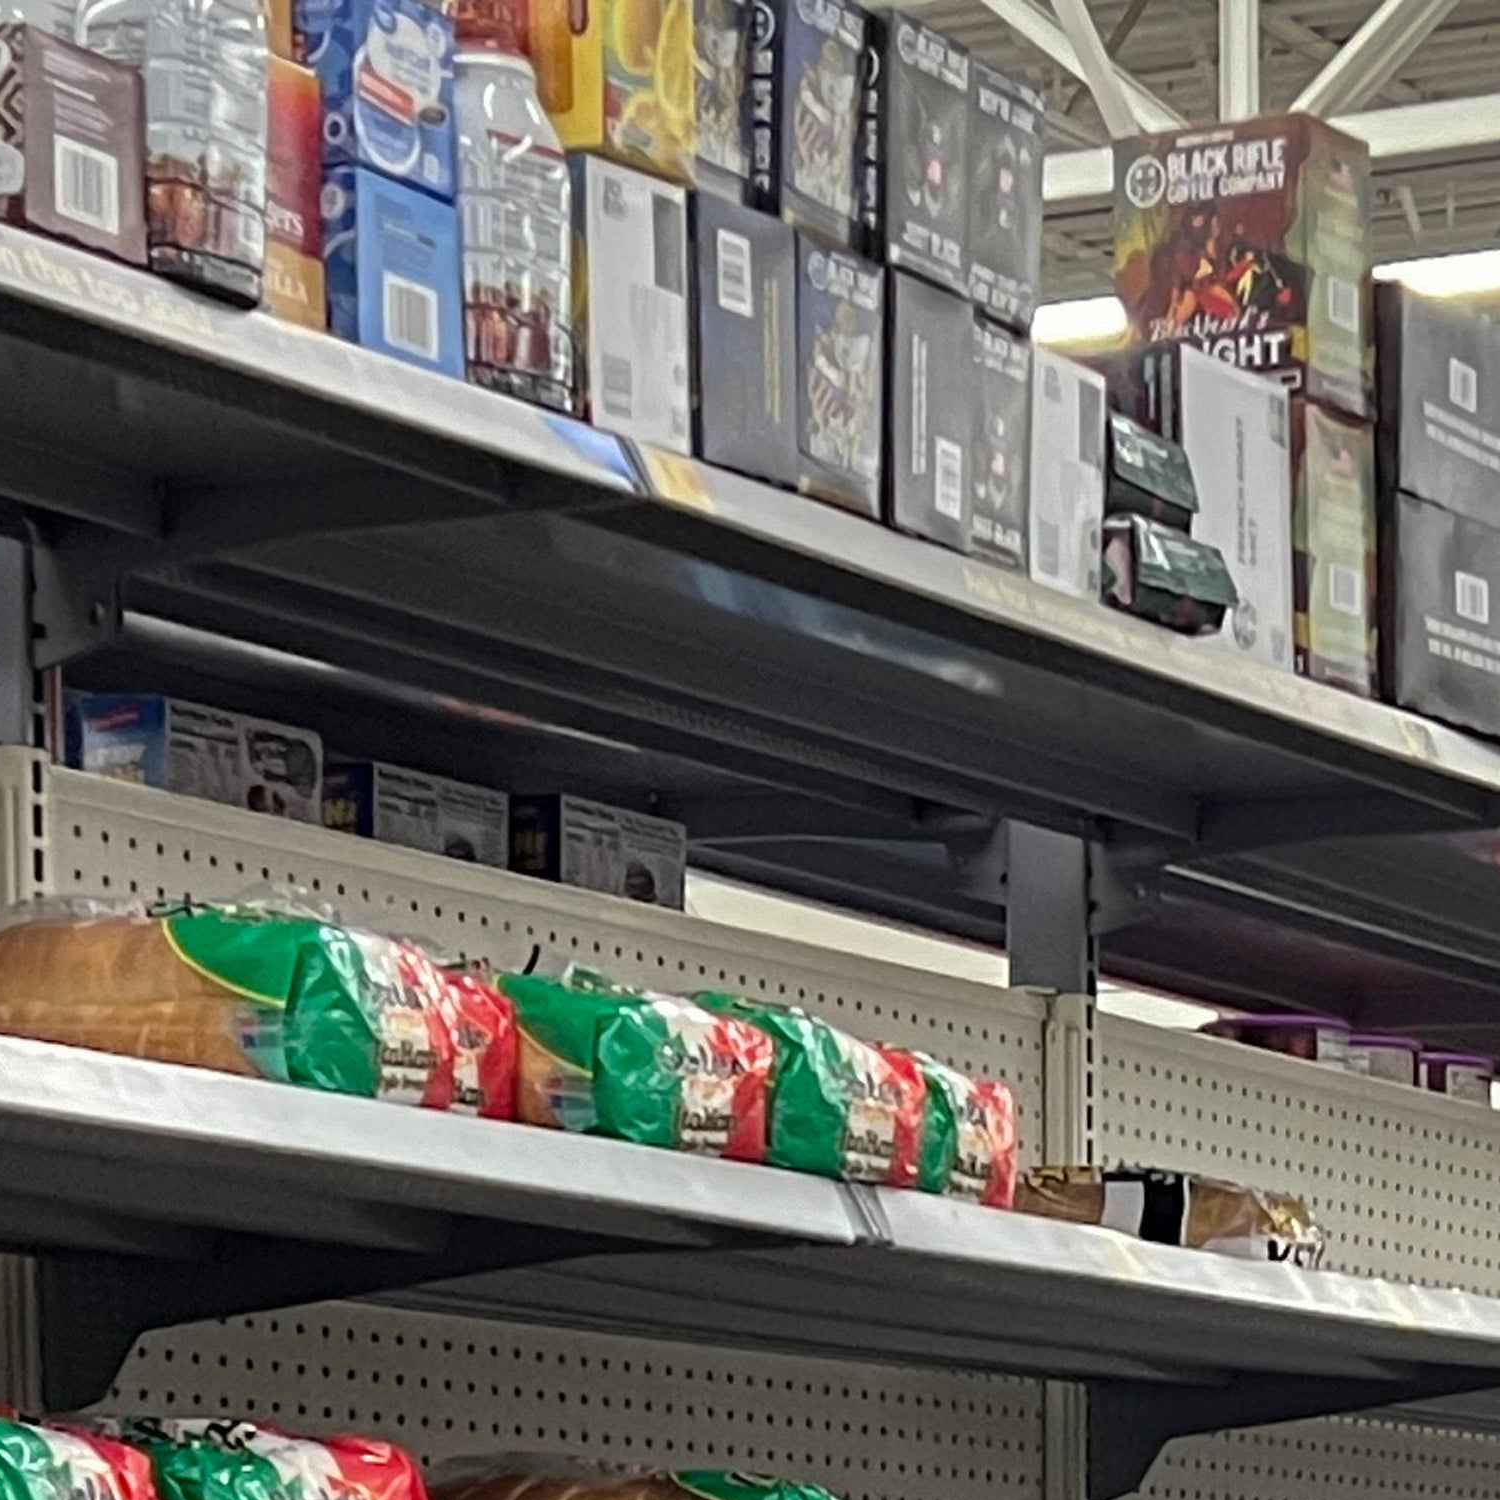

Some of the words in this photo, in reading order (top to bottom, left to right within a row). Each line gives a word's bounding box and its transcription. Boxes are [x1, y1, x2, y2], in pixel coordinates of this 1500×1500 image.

[1167, 145, 1228, 178] BLACK
[1232, 137, 1287, 174] RIFLE
[1218, 170, 1285, 197] COMPANY
[20, 246, 77, 297] the
[1203, 333, 1286, 366] IGHT
